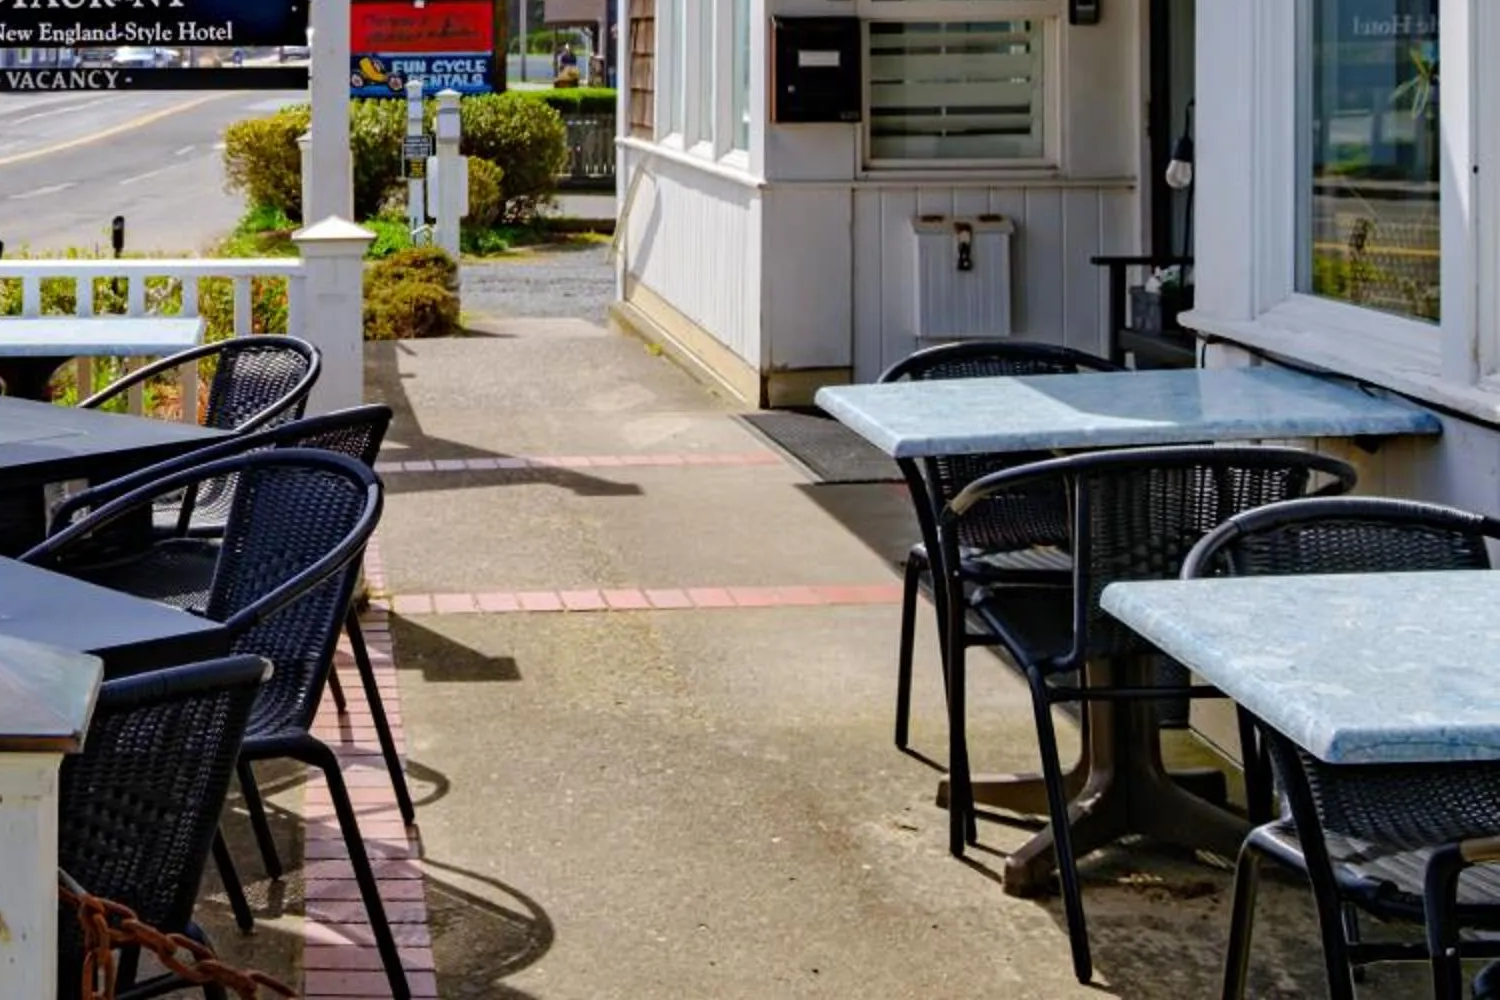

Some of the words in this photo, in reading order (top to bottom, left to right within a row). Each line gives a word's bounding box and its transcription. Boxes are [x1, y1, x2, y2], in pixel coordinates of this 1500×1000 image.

[39, 22, 173, 45] England-Style
[178, 21, 233, 41] Hotel
[392, 60, 426, 73] FUN
[432, 60, 486, 73] CYCLE
[6, 70, 120, 89] VACANCY
